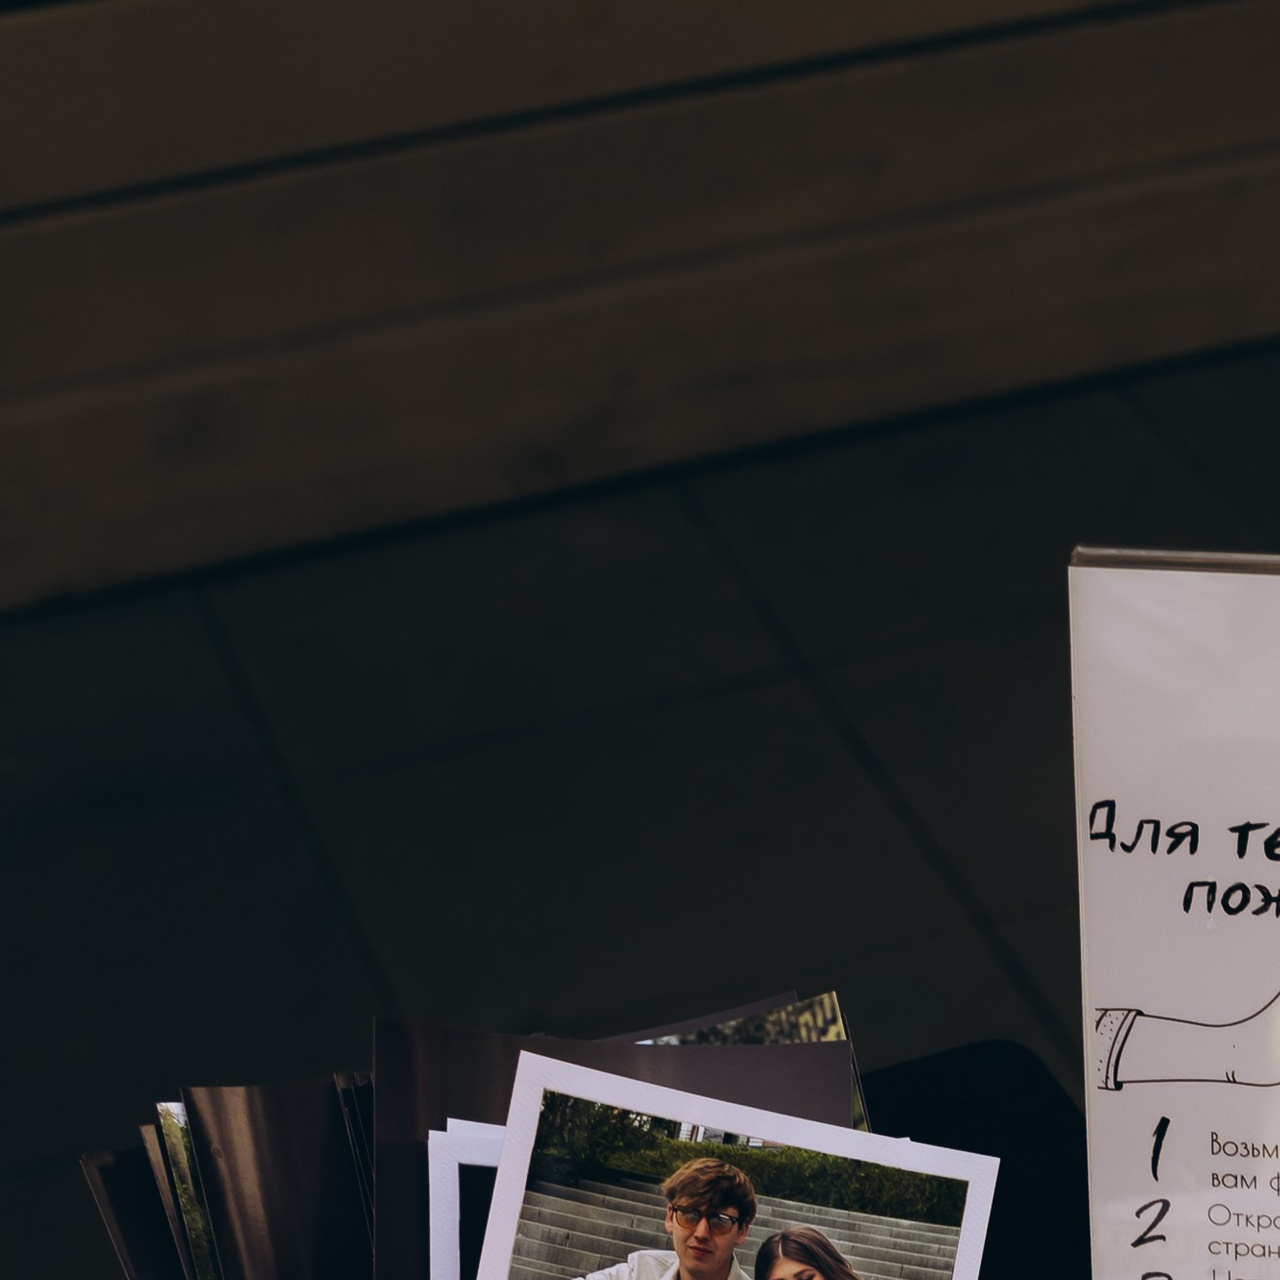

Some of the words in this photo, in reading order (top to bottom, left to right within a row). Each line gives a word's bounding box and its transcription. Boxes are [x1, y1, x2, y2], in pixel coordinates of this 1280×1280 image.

[1089, 800, 1199, 858] Для
[1150, 1116, 1170, 1181] 1
[1211, 1173, 1258, 1191] вам
[1131, 1199, 1171, 1248] 2
